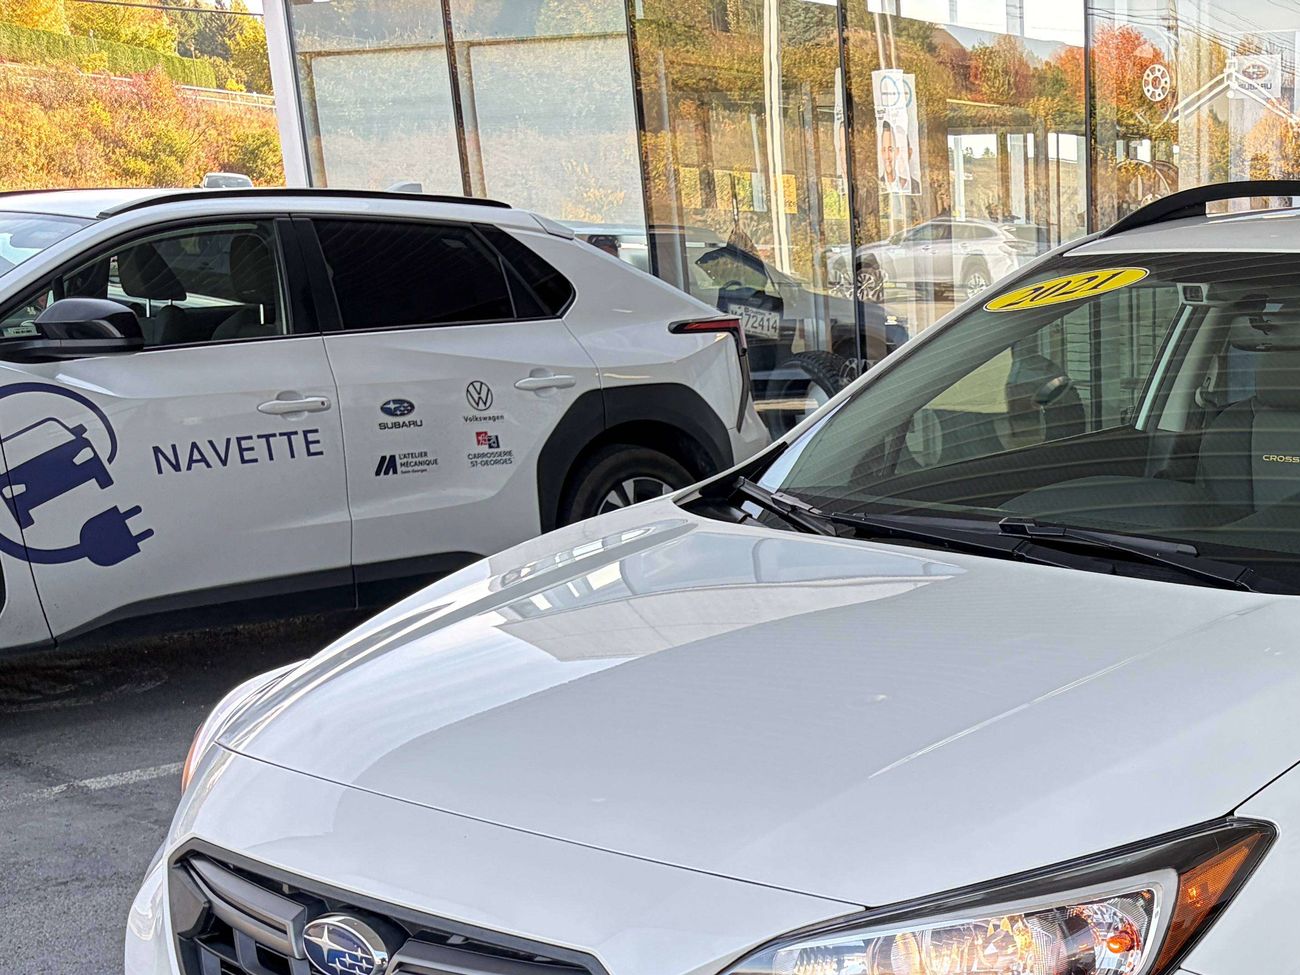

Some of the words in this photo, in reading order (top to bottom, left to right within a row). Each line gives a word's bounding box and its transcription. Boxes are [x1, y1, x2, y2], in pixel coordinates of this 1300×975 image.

[999, 270, 1127, 309] 2021
[463, 414, 505, 423] Volkswagen
[378, 419, 423, 430] SUBARU
[151, 428, 324, 475] NAVETTE
[398, 451, 428, 460] L'ATELIER
[467, 450, 513, 460] CARROSSERIE
[400, 458, 440, 468] MÉCANIQUE
[470, 458, 513, 467] ST-GEORGES
